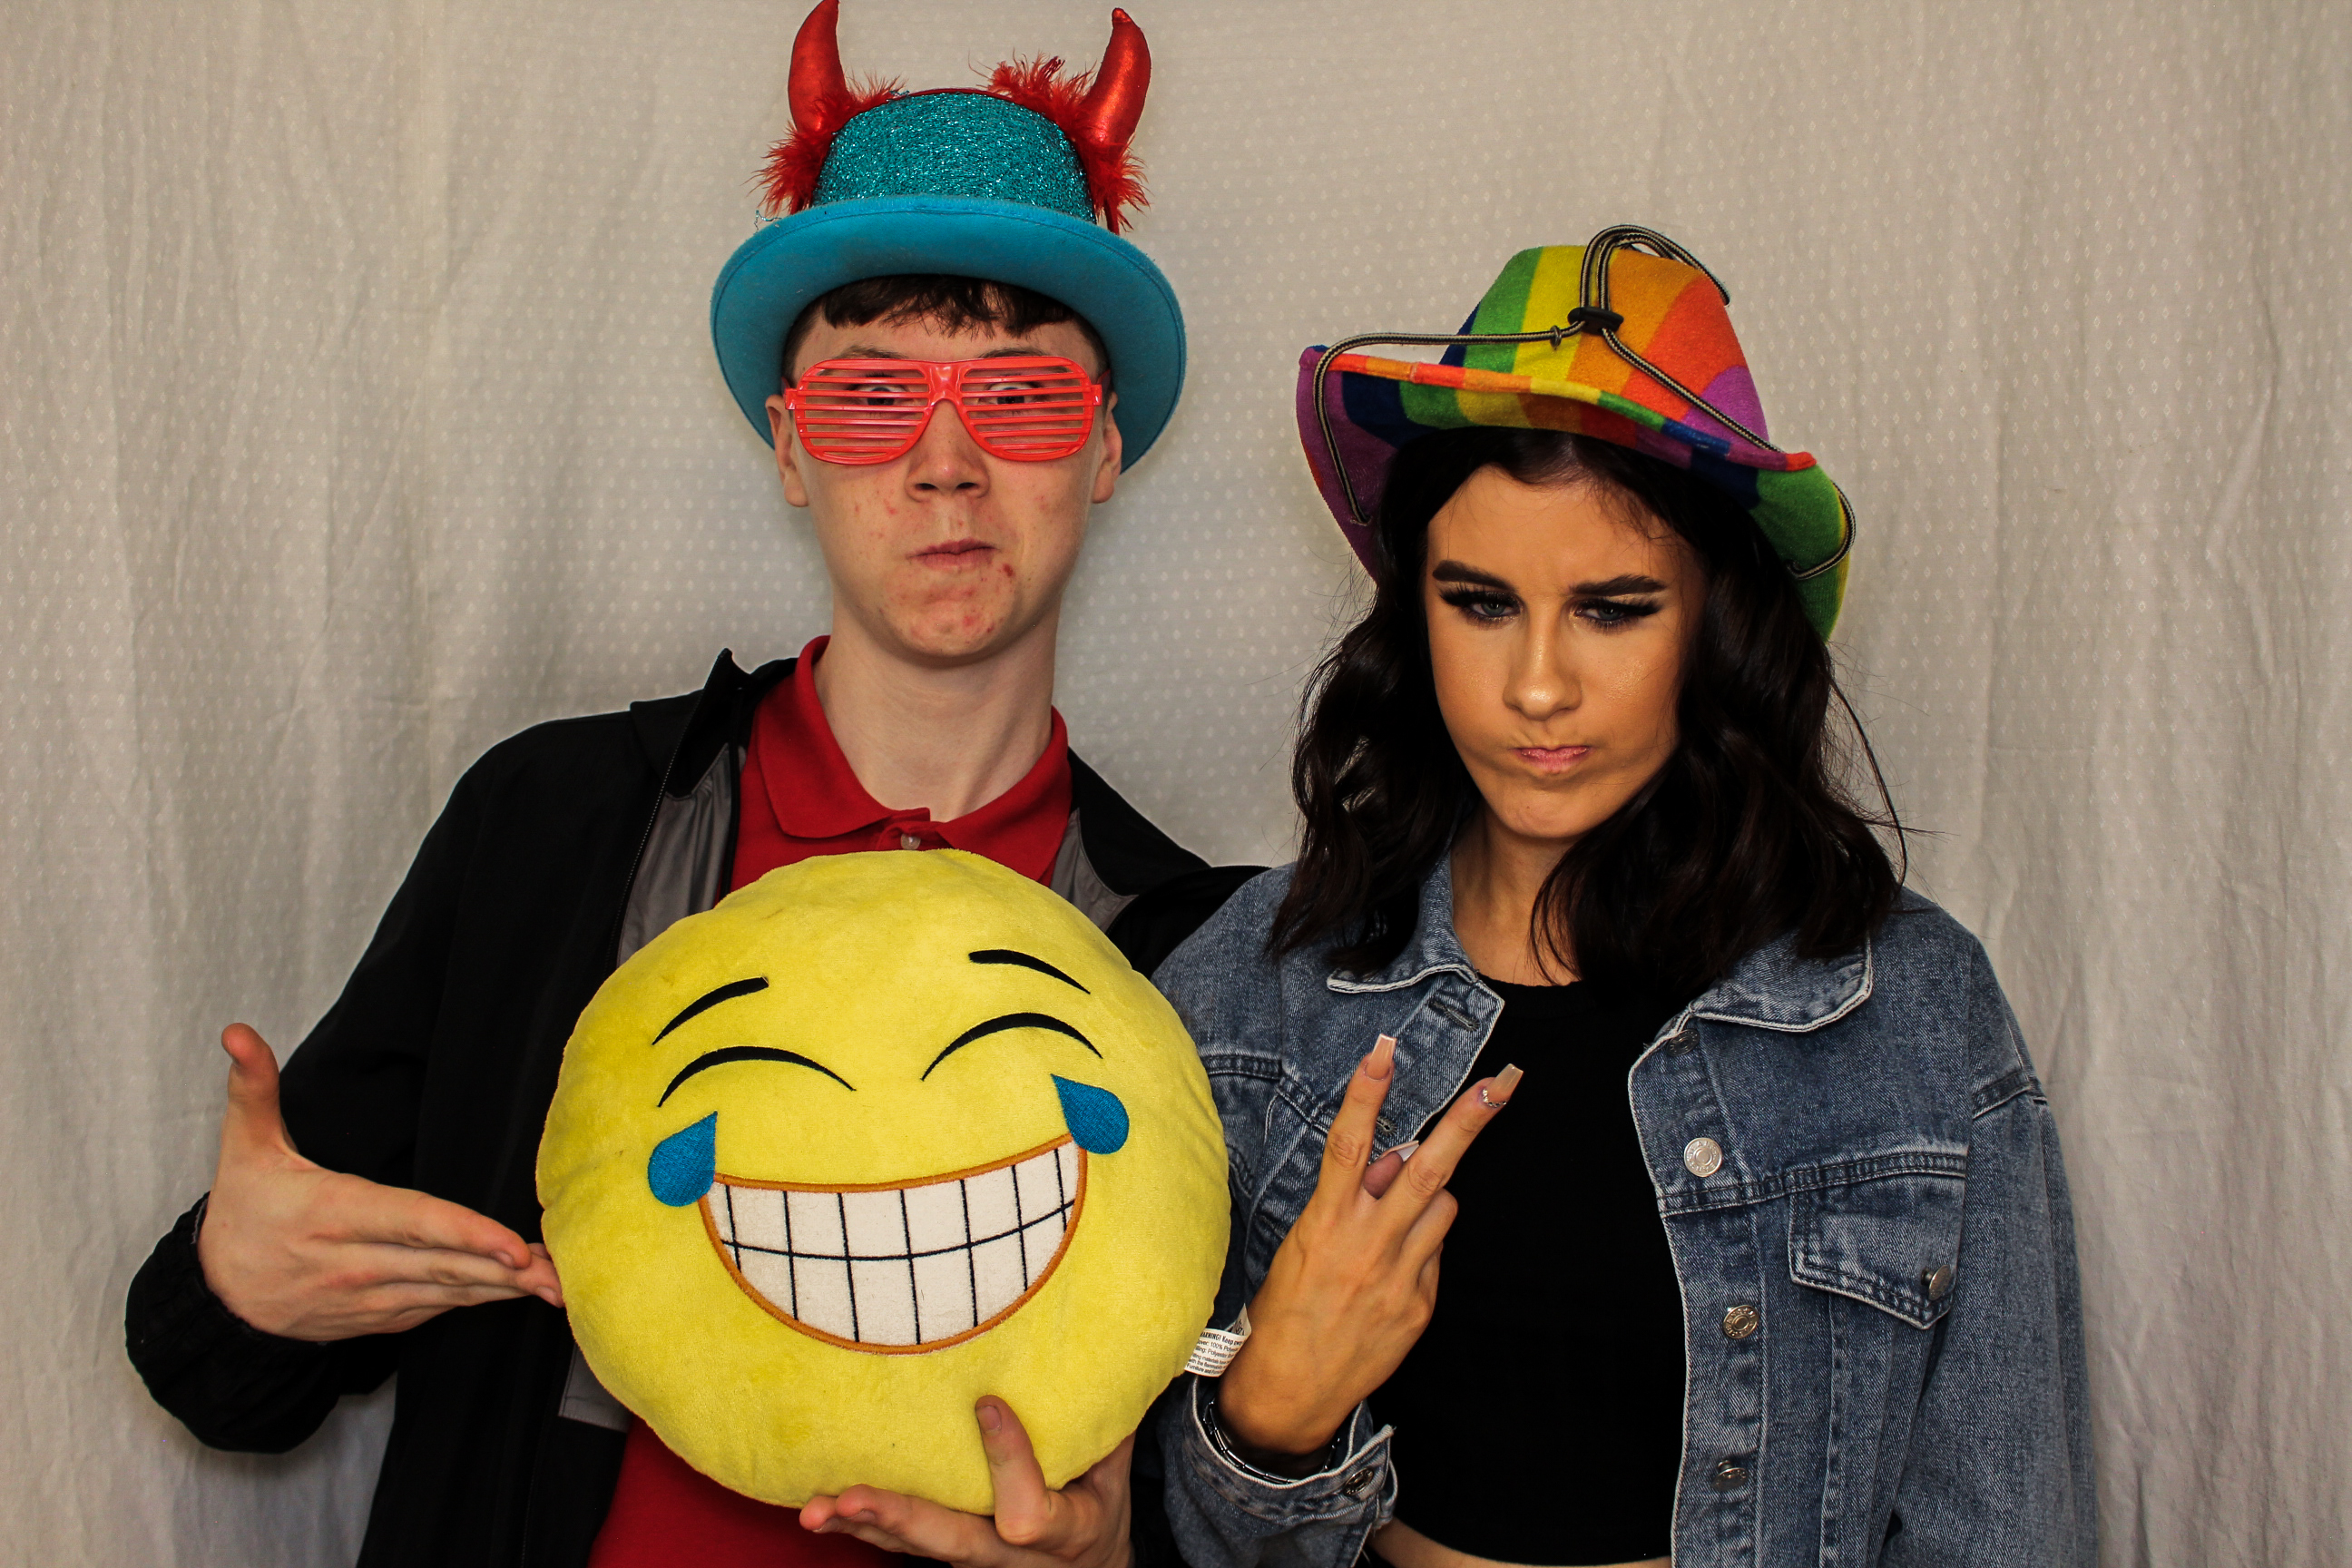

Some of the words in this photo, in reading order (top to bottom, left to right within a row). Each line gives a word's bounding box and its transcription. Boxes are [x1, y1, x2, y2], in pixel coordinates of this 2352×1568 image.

[1200, 1331, 1221, 1341] ARNING!
[1221, 1336, 1233, 1346] Keep
[1210, 1341, 1222, 1350] 100%
[1208, 1348, 1228, 1357] Polyester
